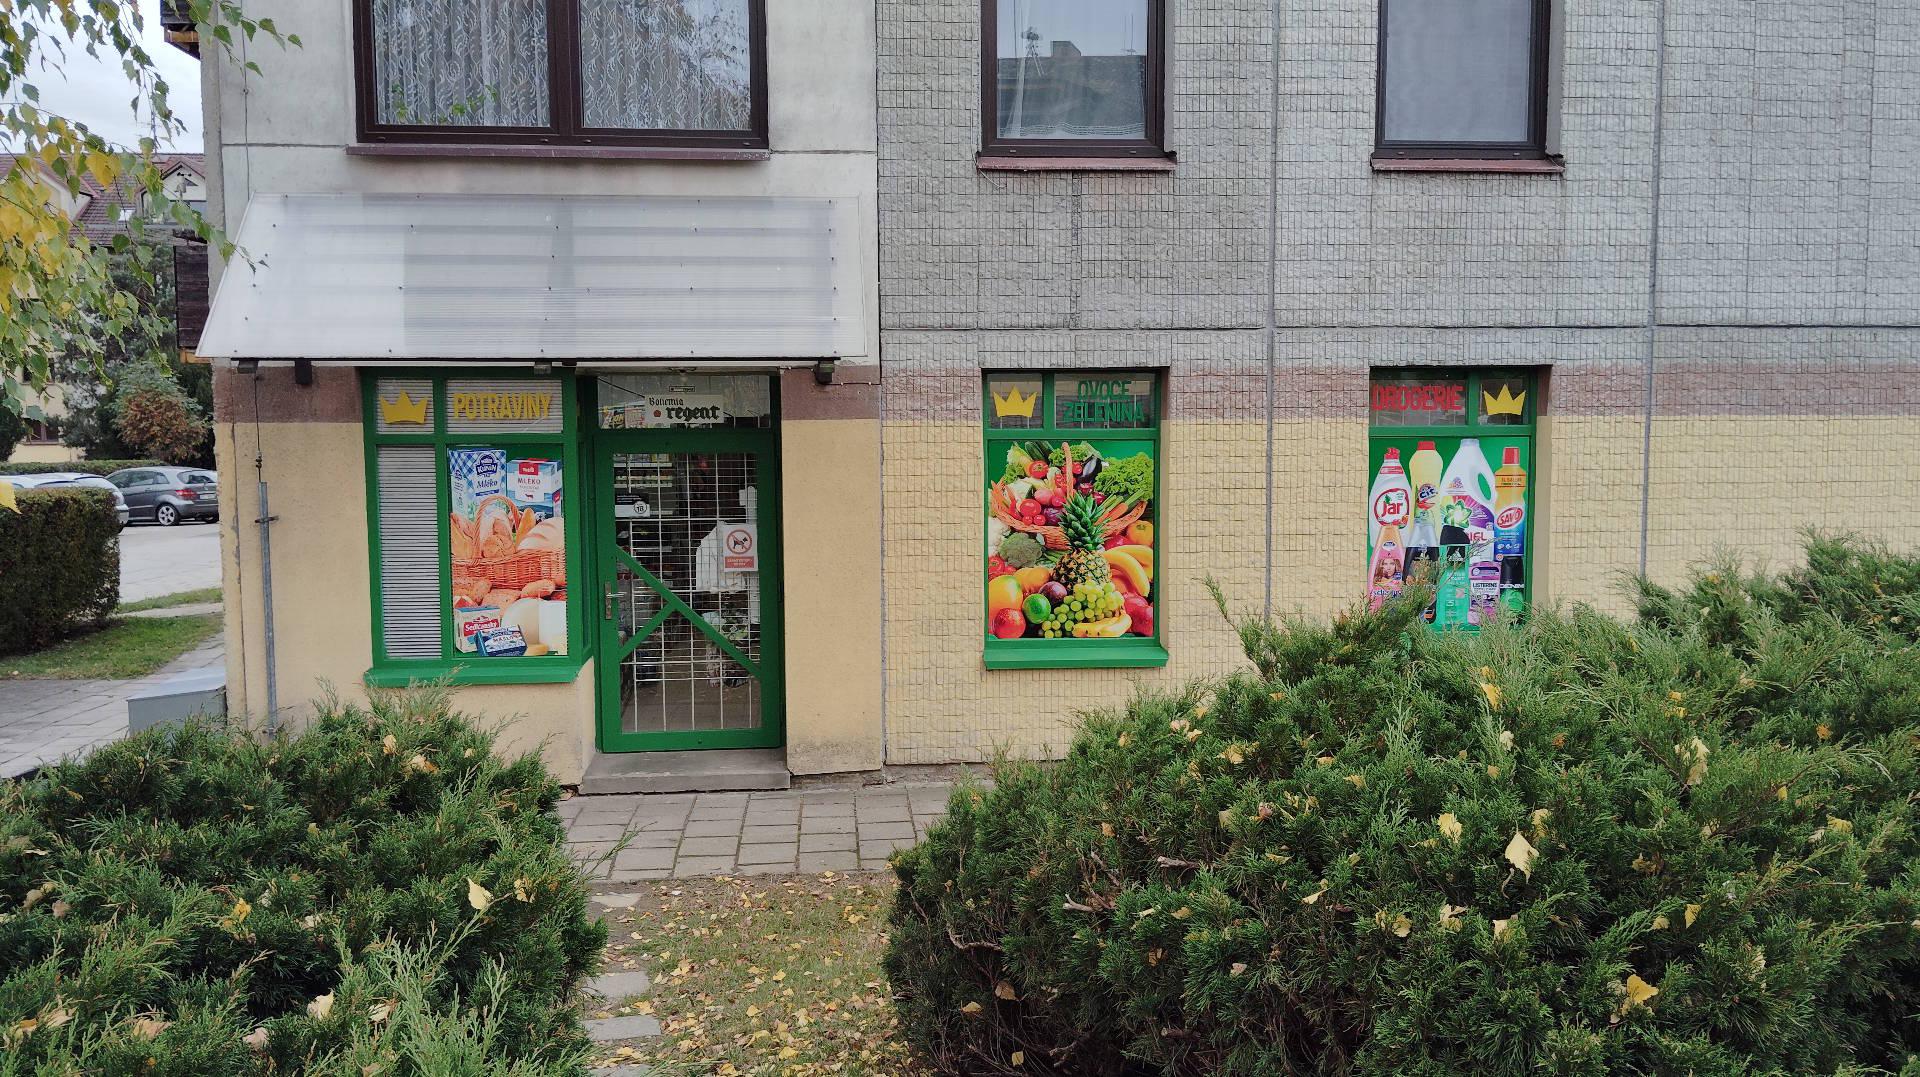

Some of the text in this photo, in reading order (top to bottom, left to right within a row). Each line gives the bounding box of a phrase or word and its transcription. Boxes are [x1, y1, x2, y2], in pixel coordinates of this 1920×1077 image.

[1077, 380, 1132, 400] OVOCE
[1372, 384, 1464, 411] DROGERIE
[453, 391, 552, 420] POTRAVINY
[648, 397, 684, 406] Bohemia
[1062, 401, 1145, 422] ZELENINA
[665, 405, 720, 422] regent
